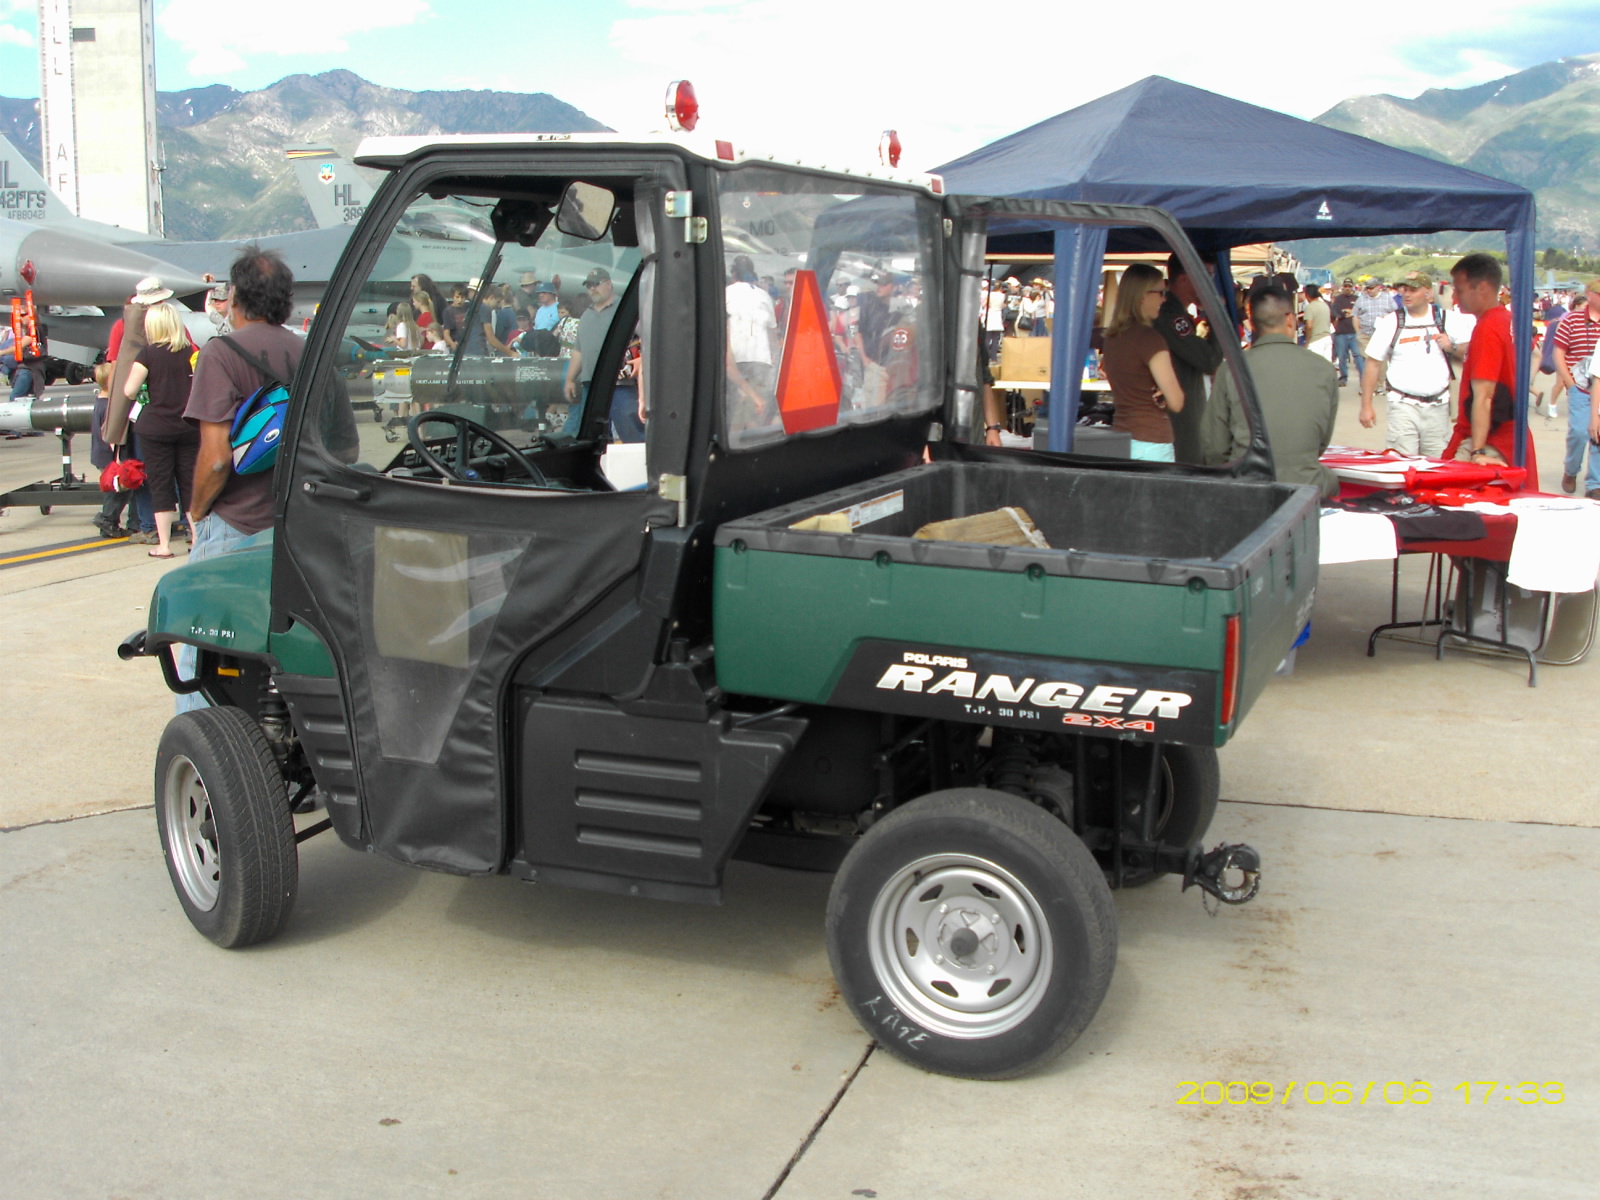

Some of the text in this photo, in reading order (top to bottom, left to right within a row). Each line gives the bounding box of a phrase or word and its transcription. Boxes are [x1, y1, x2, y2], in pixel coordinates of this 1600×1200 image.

[0, 160, 19, 189] L
[334, 184, 361, 206] HL
[221, 630, 235, 639] PSI
[903, 652, 968, 669] POLARIS
[876, 664, 1192, 719] RANGER
[964, 704, 1040, 720] T.P. 30 PSI
[1063, 713, 1155, 733] 2X4
